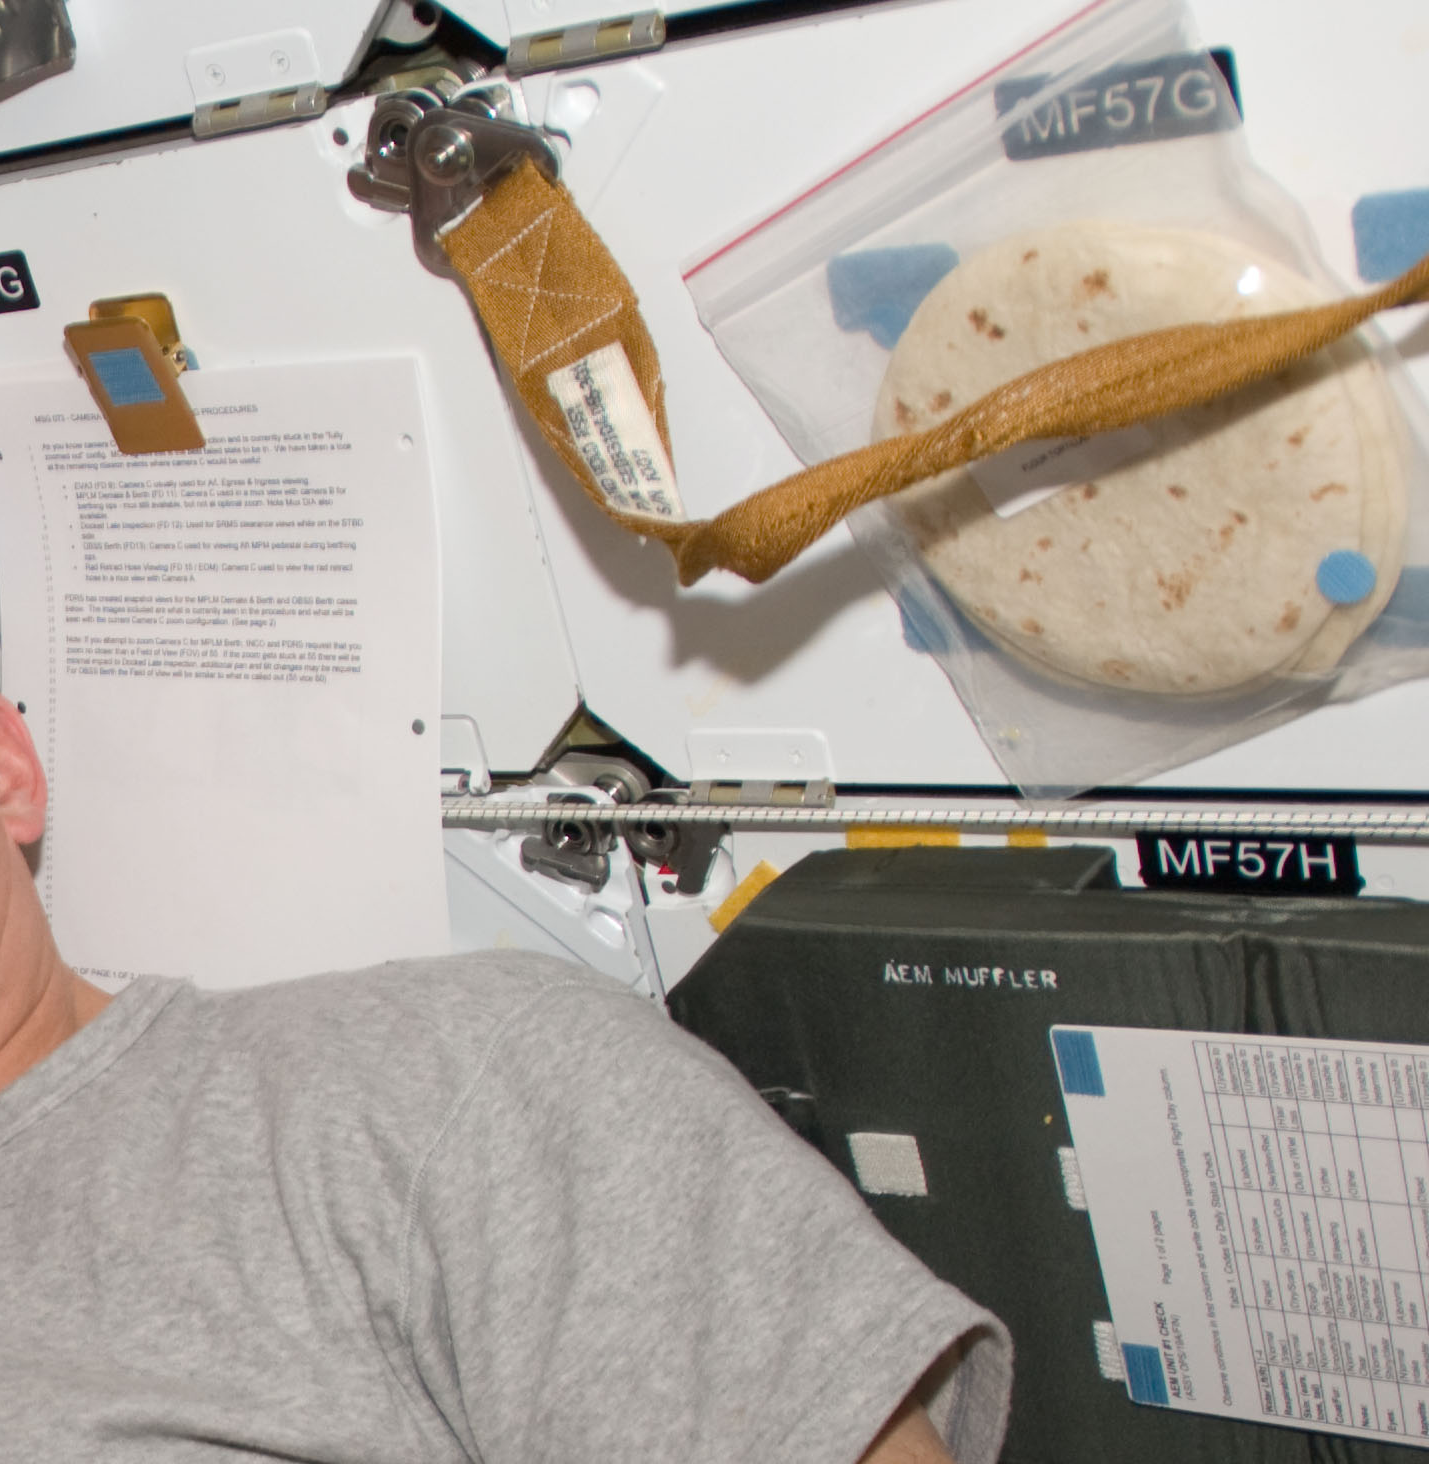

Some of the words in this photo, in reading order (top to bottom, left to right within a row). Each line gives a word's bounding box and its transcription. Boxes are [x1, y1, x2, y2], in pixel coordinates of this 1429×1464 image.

[1017, 69, 1217, 143] MF57G
[201, 404, 258, 415] PROCEDURES
[1157, 838, 1337, 880] MF57H
[884, 962, 933, 984] AEM
[945, 967, 1059, 989] MUFFLER
[1167, 1102, 1178, 1120] Day
[1171, 1122, 1183, 1146] Flight
[1176, 1149, 1193, 1197] appropriate
[1203, 1152, 1215, 1178] Check
[1209, 1181, 1221, 1208] Status
[1151, 1210, 1165, 1236] pages
[1188, 1209, 1199, 1229] code
[1214, 1211, 1226, 1232] Daily
[1192, 1231, 1203, 1251] write
[1219, 1233, 1227, 1245] for
[1196, 1253, 1207, 1269] and
[1221, 1247, 1233, 1274] Codes
[1161, 1263, 1171, 1284] Page
[1201, 1271, 1213, 1301] column
[1228, 1287, 1240, 1309] Table
[1154, 1302, 1169, 1336] CHECK
[1205, 1302, 1215, 1318] first
[1163, 1351, 1177, 1374] UNIT
[1212, 1330, 1226, 1371] conditions
[1169, 1377, 1181, 1398] AEM
[1220, 1372, 1233, 1406] Observe
